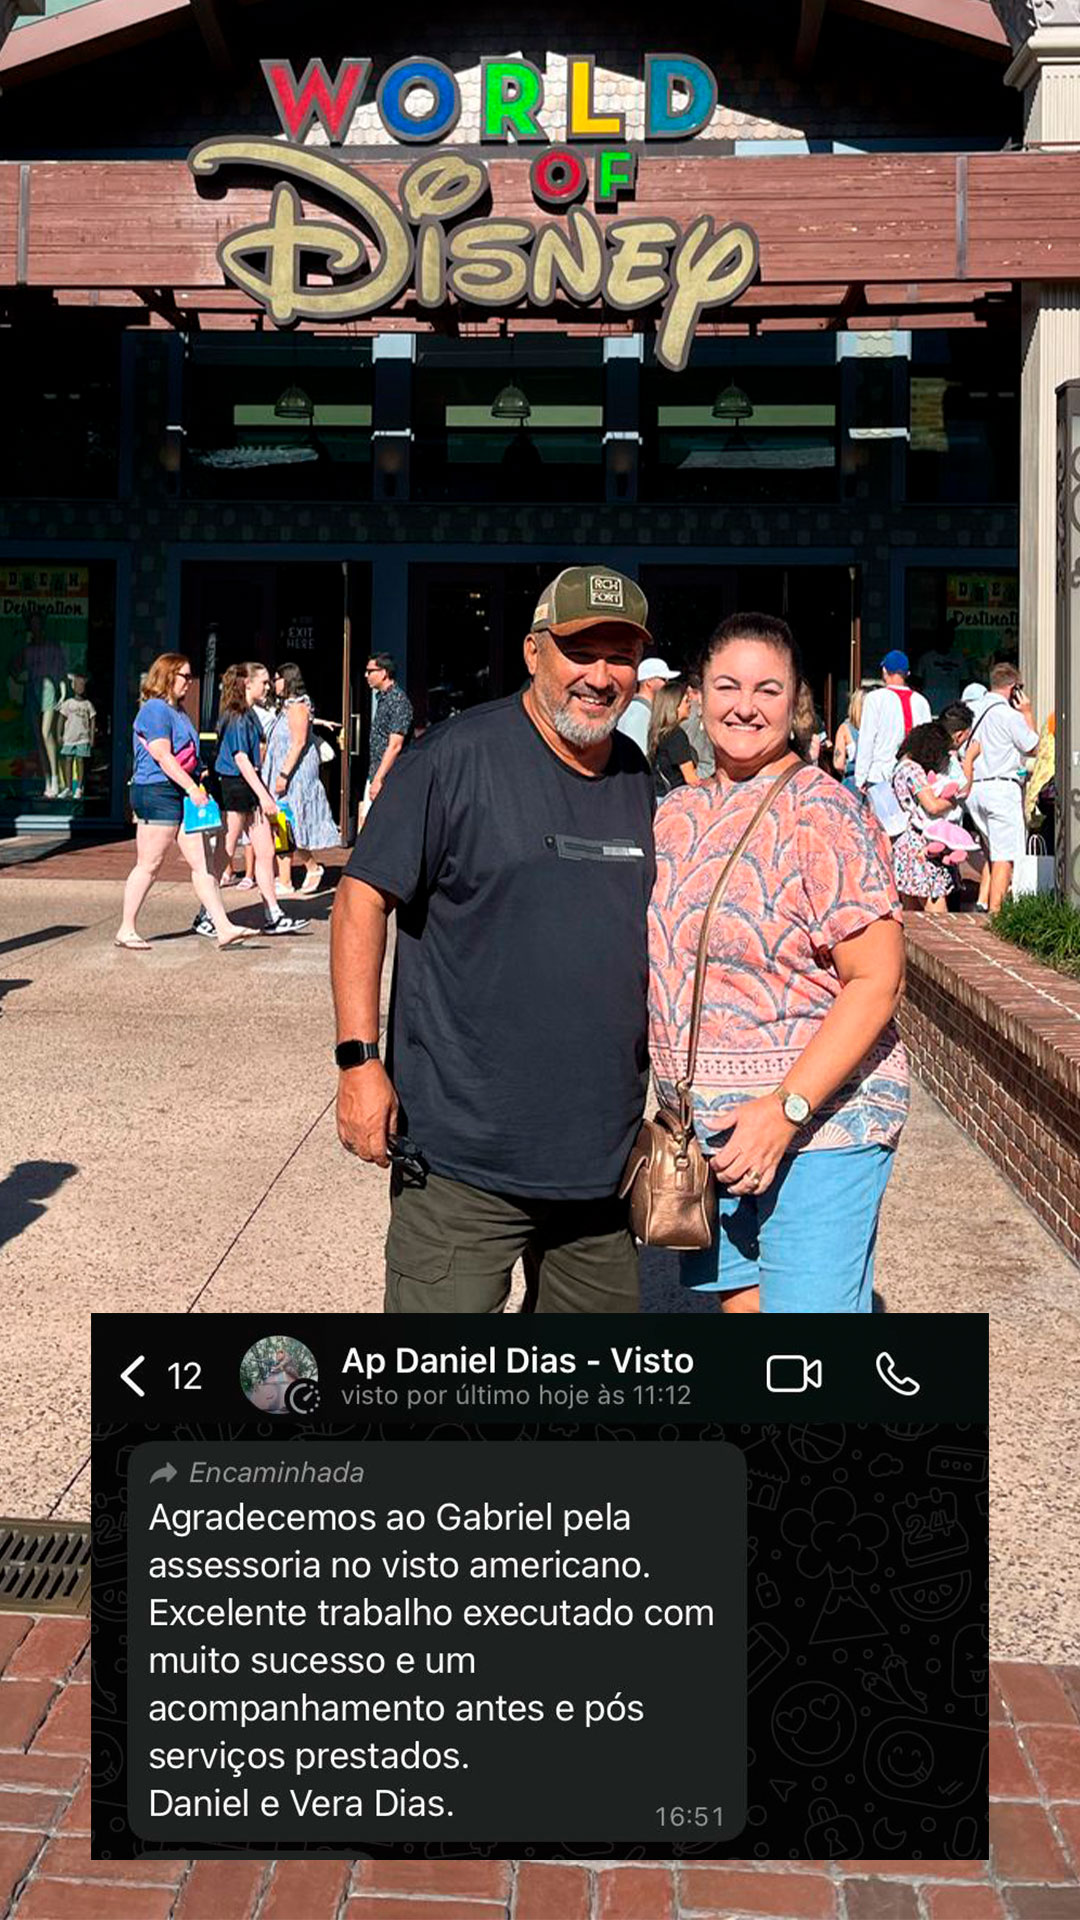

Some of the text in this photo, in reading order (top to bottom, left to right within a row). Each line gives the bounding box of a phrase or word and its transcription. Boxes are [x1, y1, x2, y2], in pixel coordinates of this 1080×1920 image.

[259, 52, 718, 144] WORLD
[530, 145, 636, 206] OF
[286, 639, 314, 649] HERE
[288, 627, 313, 638] EXIT
